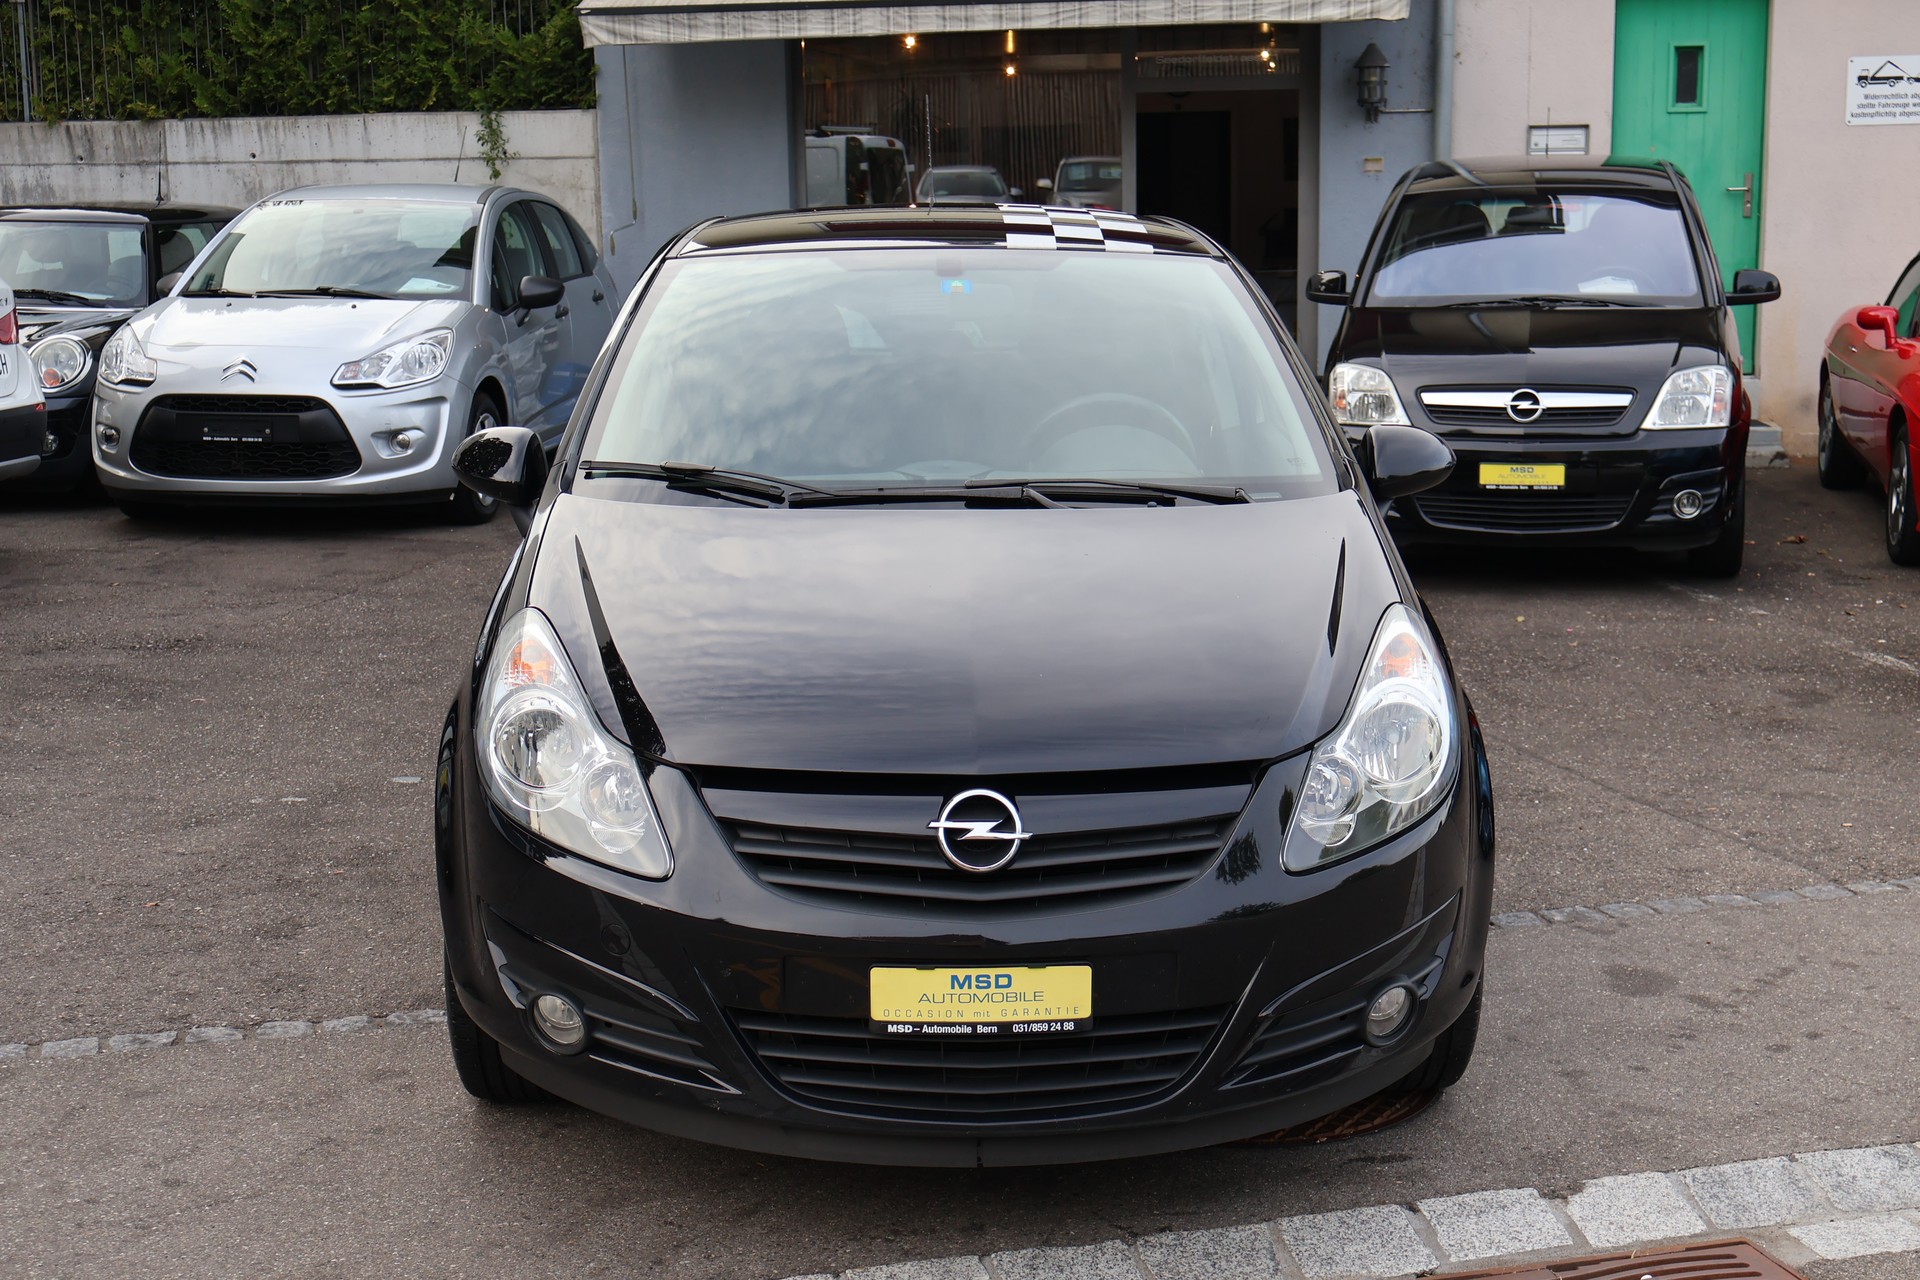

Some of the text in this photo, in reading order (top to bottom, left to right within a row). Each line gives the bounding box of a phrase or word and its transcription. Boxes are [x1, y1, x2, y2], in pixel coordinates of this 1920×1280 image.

[950, 973, 1013, 990] MSD
[918, 991, 1045, 1004] AUTOMOBILE
[883, 1006, 1080, 1018] OCCASION mit GARANTIE
[922, 1024, 972, 1034] Automobile
[976, 1024, 998, 1034] Bern
[1012, 1022, 1049, 1033] 031/859
[1050, 1022, 1062, 1031] 24
[1063, 1021, 1075, 1031] 88
